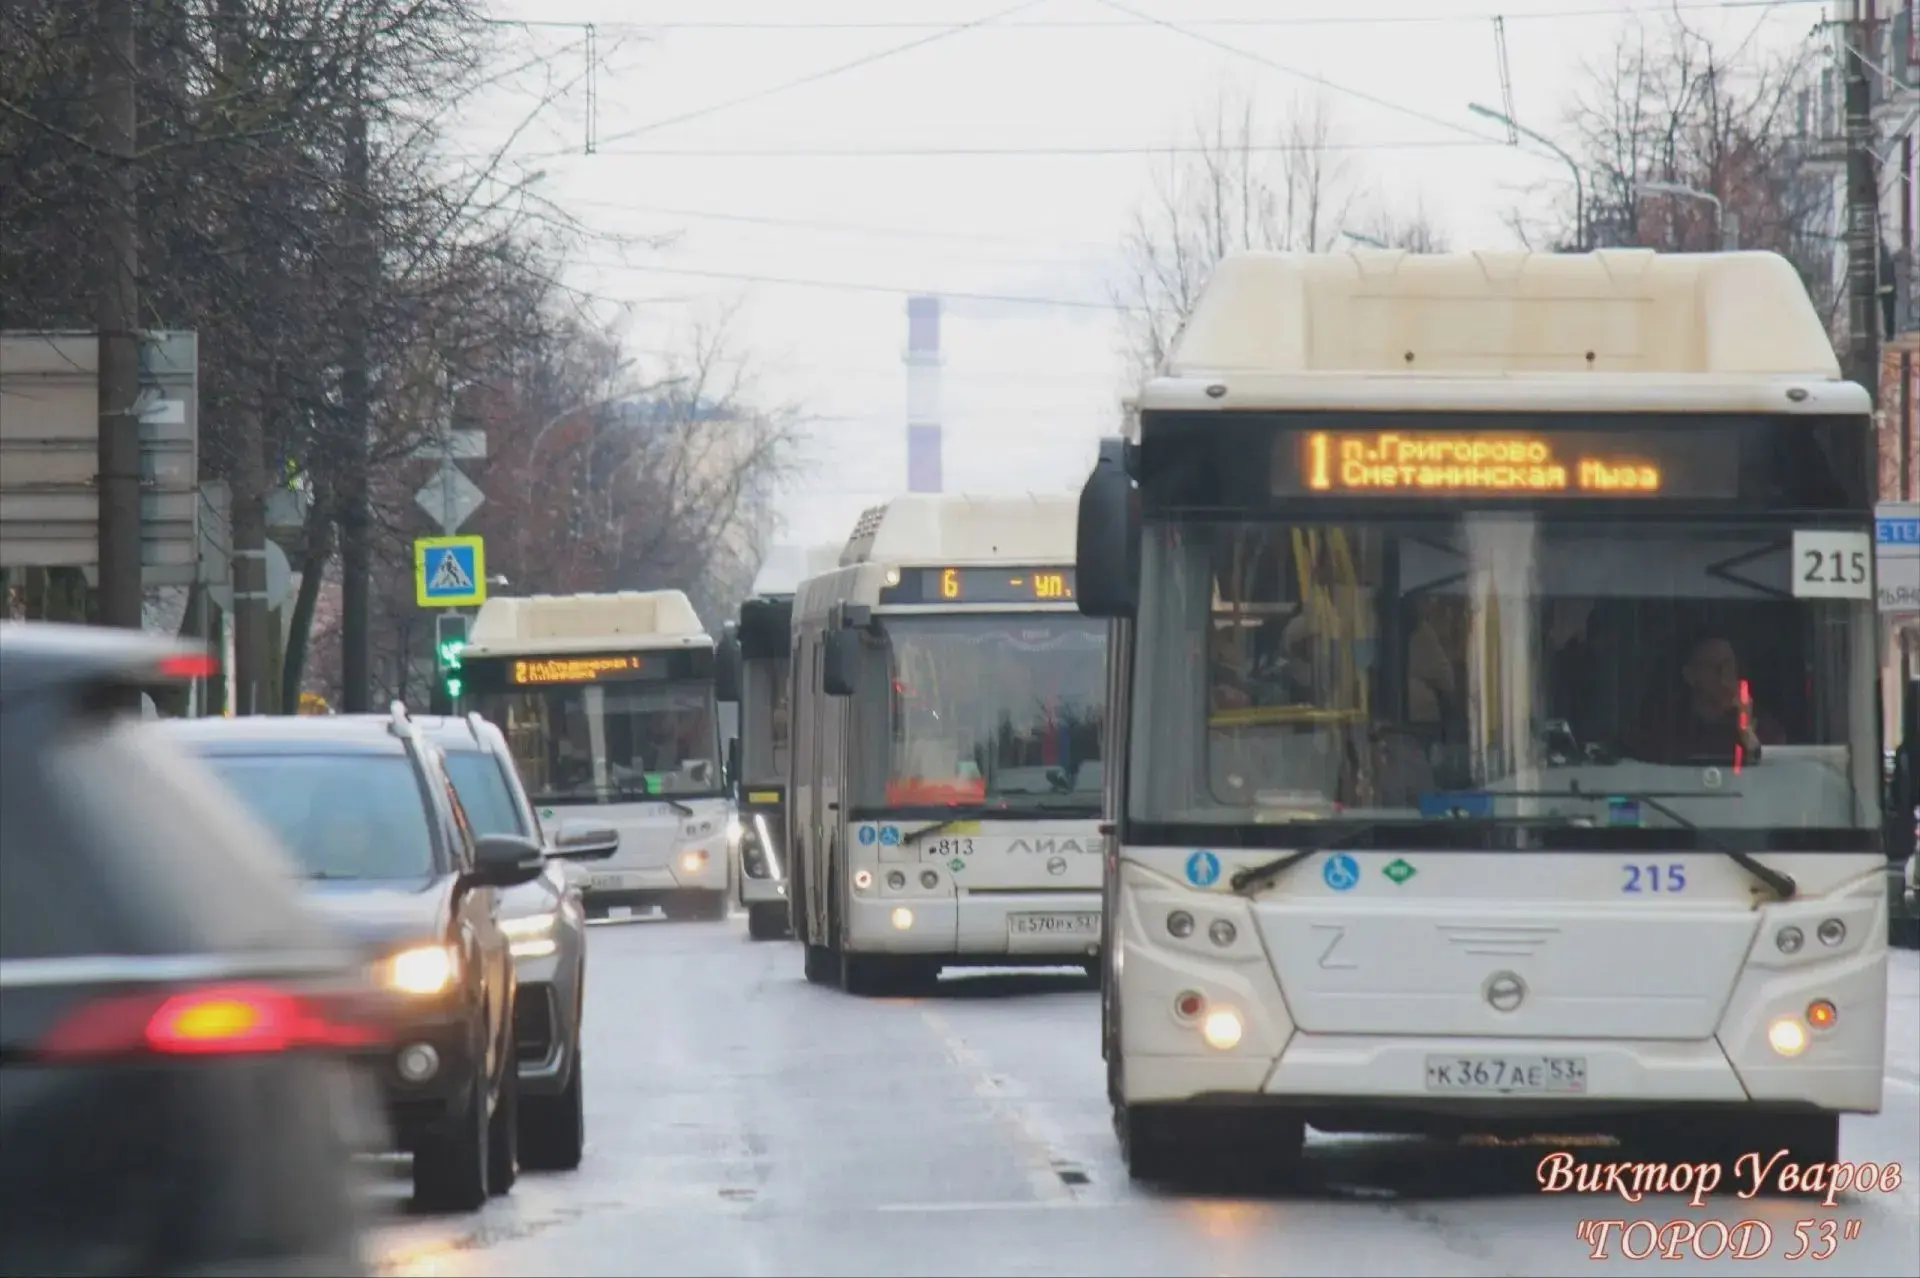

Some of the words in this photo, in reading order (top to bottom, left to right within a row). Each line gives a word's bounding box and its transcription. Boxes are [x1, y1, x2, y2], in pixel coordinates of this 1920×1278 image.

[1310, 431, 1330, 488] 1
[1341, 434, 1550, 463] п.Григорово
[1804, 549, 1866, 585] 215
[943, 568, 959, 598] 6
[938, 838, 974, 856] 813
[1621, 864, 1687, 893] 215
